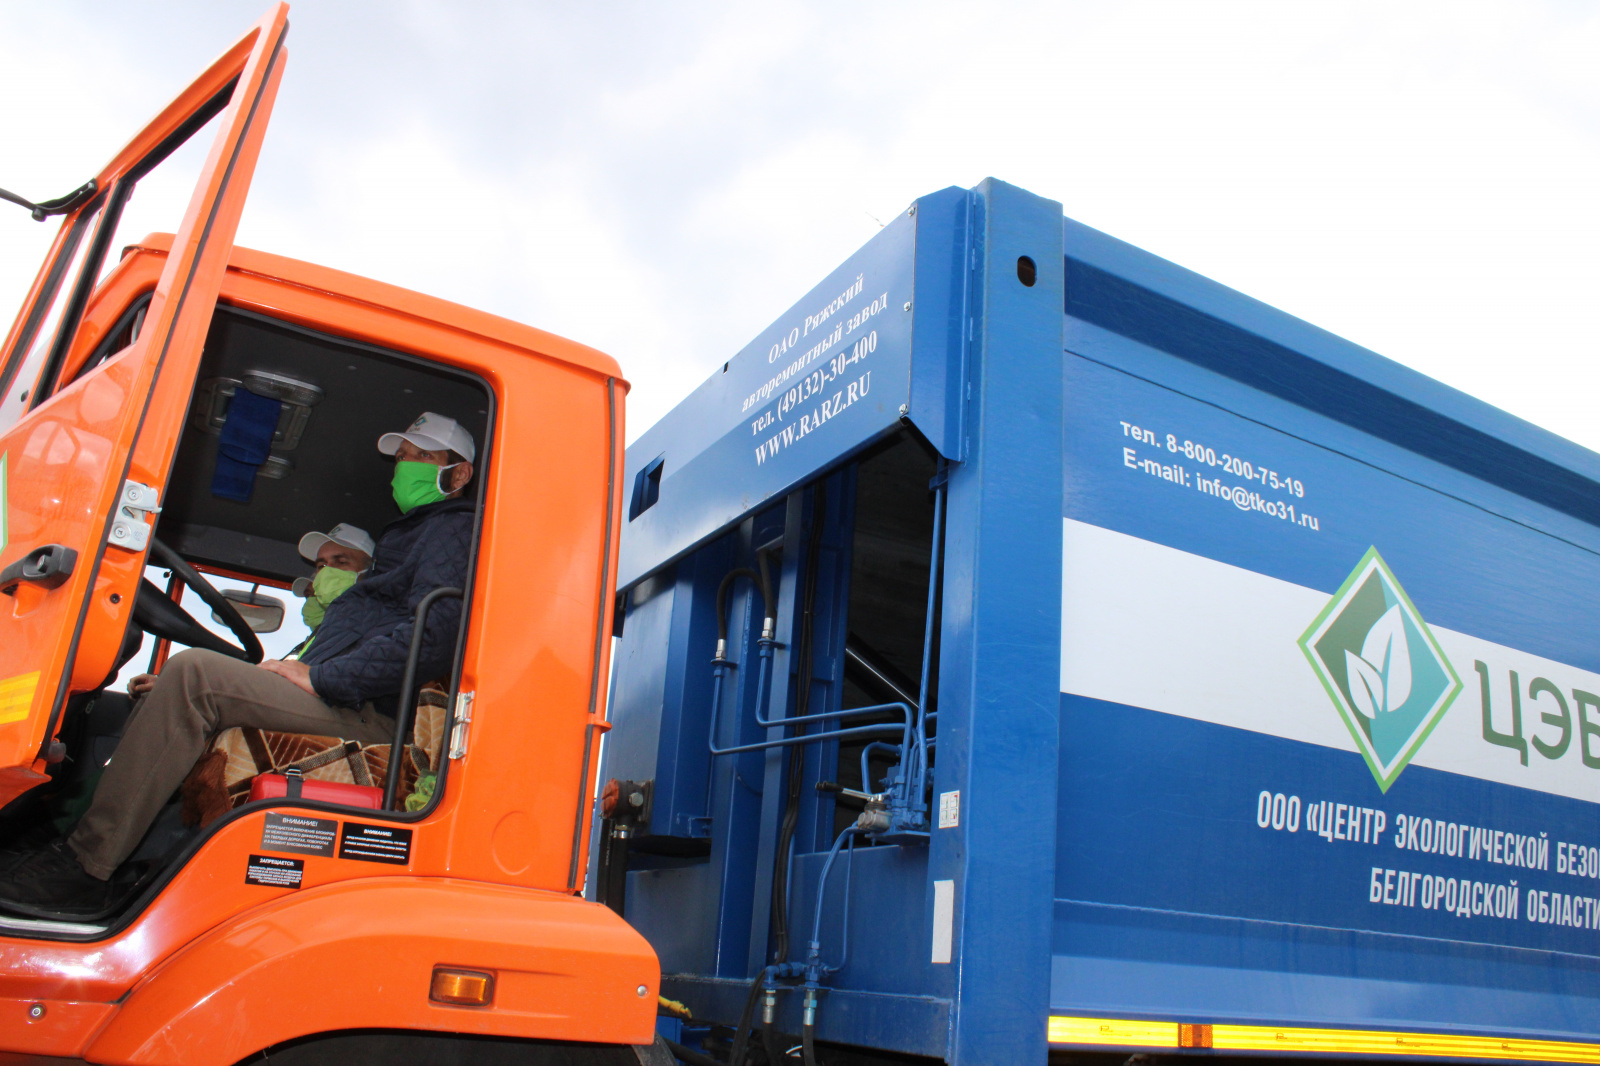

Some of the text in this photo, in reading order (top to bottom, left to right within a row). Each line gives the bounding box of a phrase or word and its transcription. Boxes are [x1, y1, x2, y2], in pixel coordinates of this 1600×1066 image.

[742, 292, 888, 413] авторемонтный завод
[768, 273, 864, 364] ОАО Ряжский
[751, 330, 878, 436] тел. (49132)-30-400
[755, 371, 871, 467] WWW.RARZ.RU
[1120, 420, 1305, 498] тел. 8-800-200-75-19
[1123, 446, 1319, 531] E-mail: info@tko31.ru
[283, 817, 318, 827] ВНИМАНИЕ!
[1257, 790, 1600, 880] ООО «ЦЕНТР ЭКОЛОГИЧЕСКОЙ БЕЗО
[1369, 867, 1519, 920] БЕЛГОРОДСКОЙ
